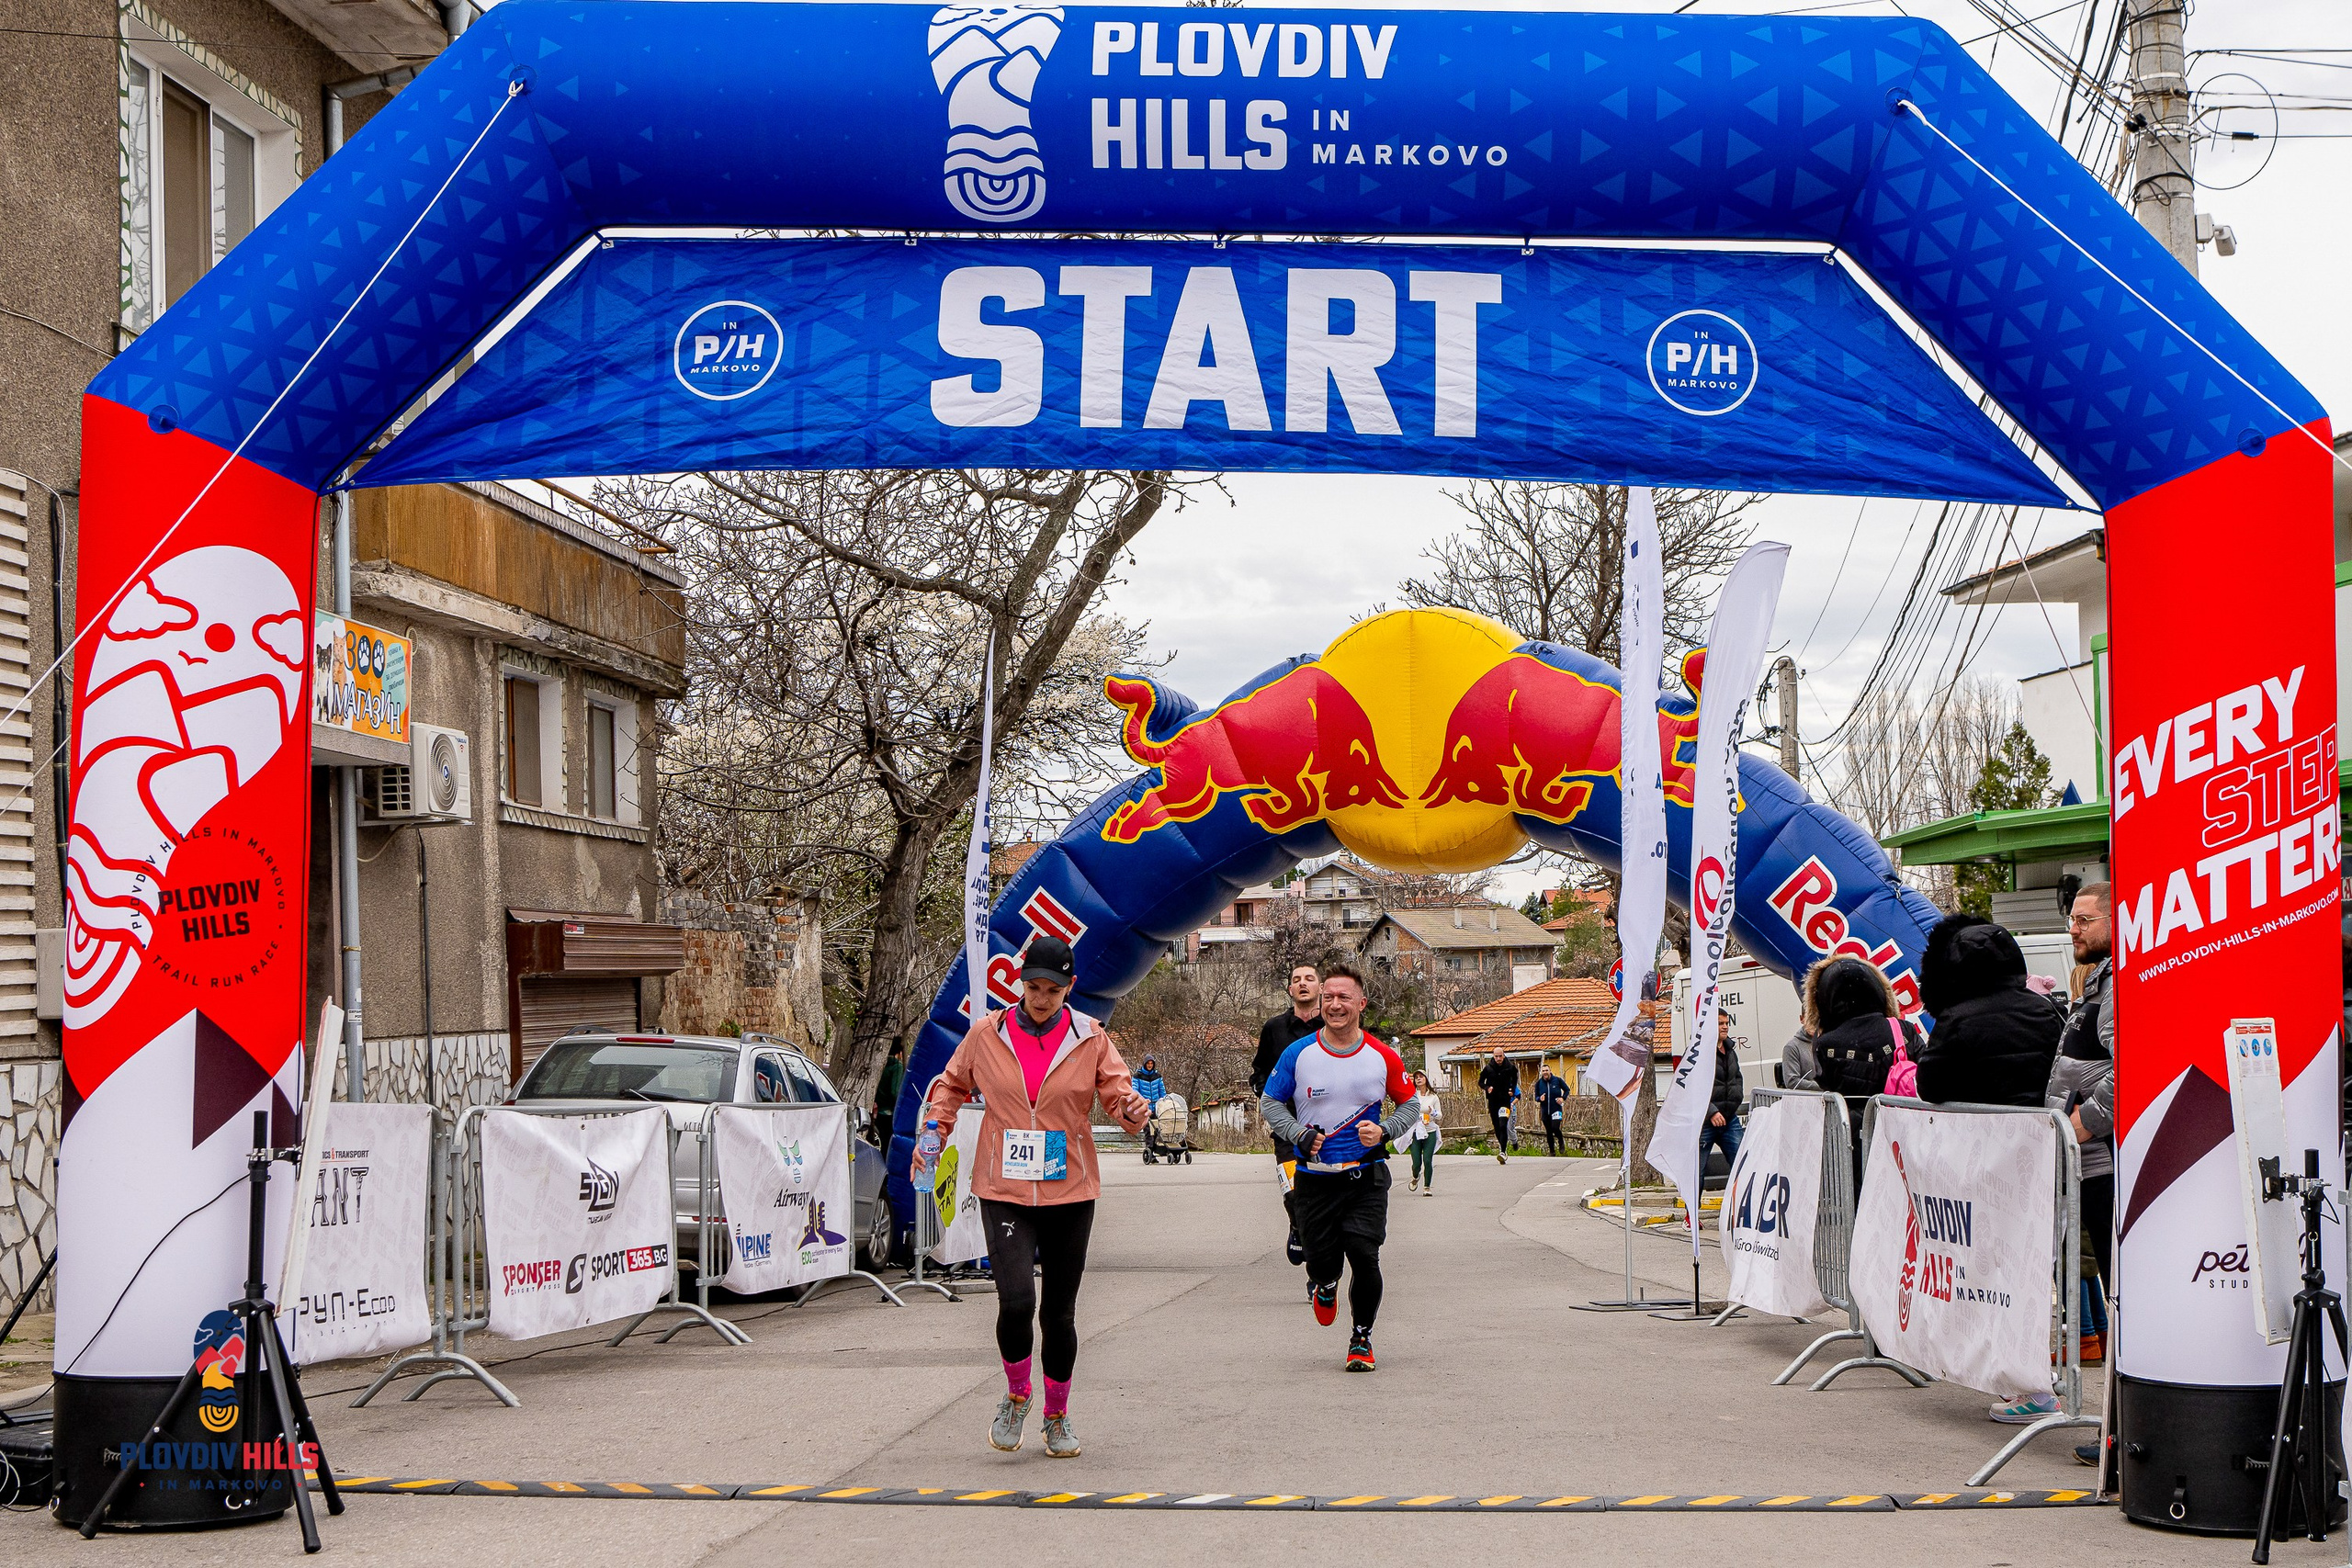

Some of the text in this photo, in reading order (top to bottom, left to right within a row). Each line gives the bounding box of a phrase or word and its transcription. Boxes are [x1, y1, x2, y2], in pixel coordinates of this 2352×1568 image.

[1092, 22, 1398, 80] PLOVDIV
[1092, 97, 1288, 171] HILLS
[1313, 109, 1351, 132] IN
[1313, 143, 1510, 168] MARKOVO
[722, 321, 738, 331] IN
[1694, 331, 1709, 340] IN
[694, 333, 765, 365] P/H
[929, 265, 1502, 439] START
[1667, 342, 1738, 377] P/H
[690, 364, 761, 375] MARKOVO
[1668, 378, 1738, 390] MARKOVO
[331, 681, 402, 734] МАГАЗИН
[2115, 664, 2305, 822] EVERY
[2201, 722, 2338, 848] STEP
[247, 837, 286, 910] MARKOVO
[157, 878, 260, 915] PLOVDIV
[182, 910, 251, 943] HILLS
[153, 940, 279, 988] TRAIL RUN RACE
[334, 1149, 369, 1159] TRANSPORT
[1010, 1144, 1035, 1161] 241
[503, 1259, 561, 1297] SPONSER
[1955, 1265, 1966, 1280] IN
[1956, 1286, 2012, 1309] MARKOVO
